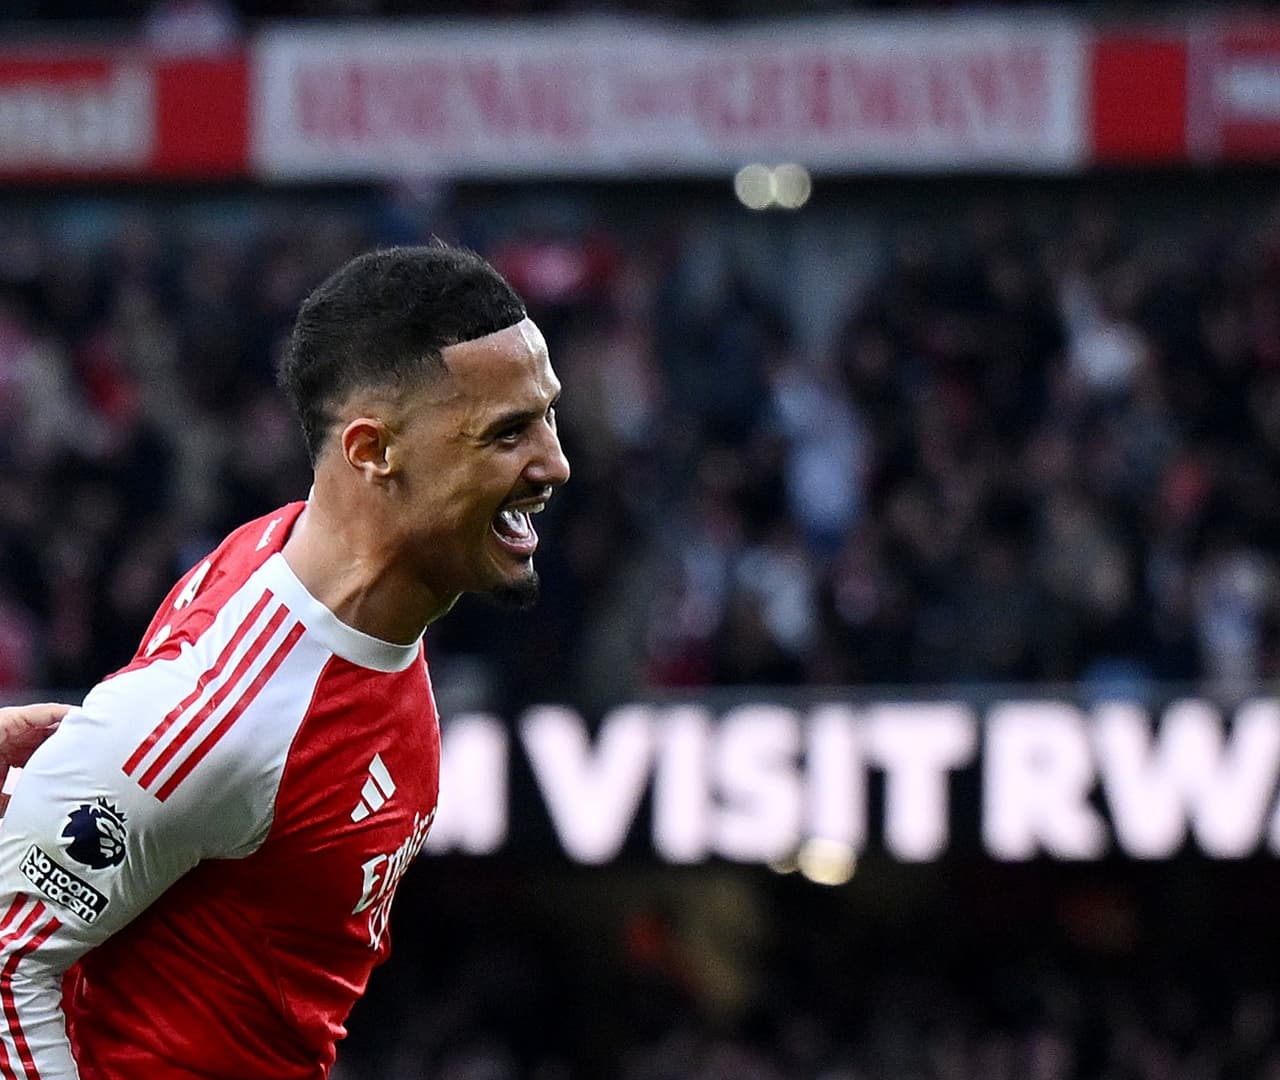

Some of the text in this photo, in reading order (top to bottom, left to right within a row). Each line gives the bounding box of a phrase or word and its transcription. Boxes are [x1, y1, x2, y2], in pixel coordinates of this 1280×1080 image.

[28, 846, 98, 906] No room
[41, 880, 96, 923] racism
